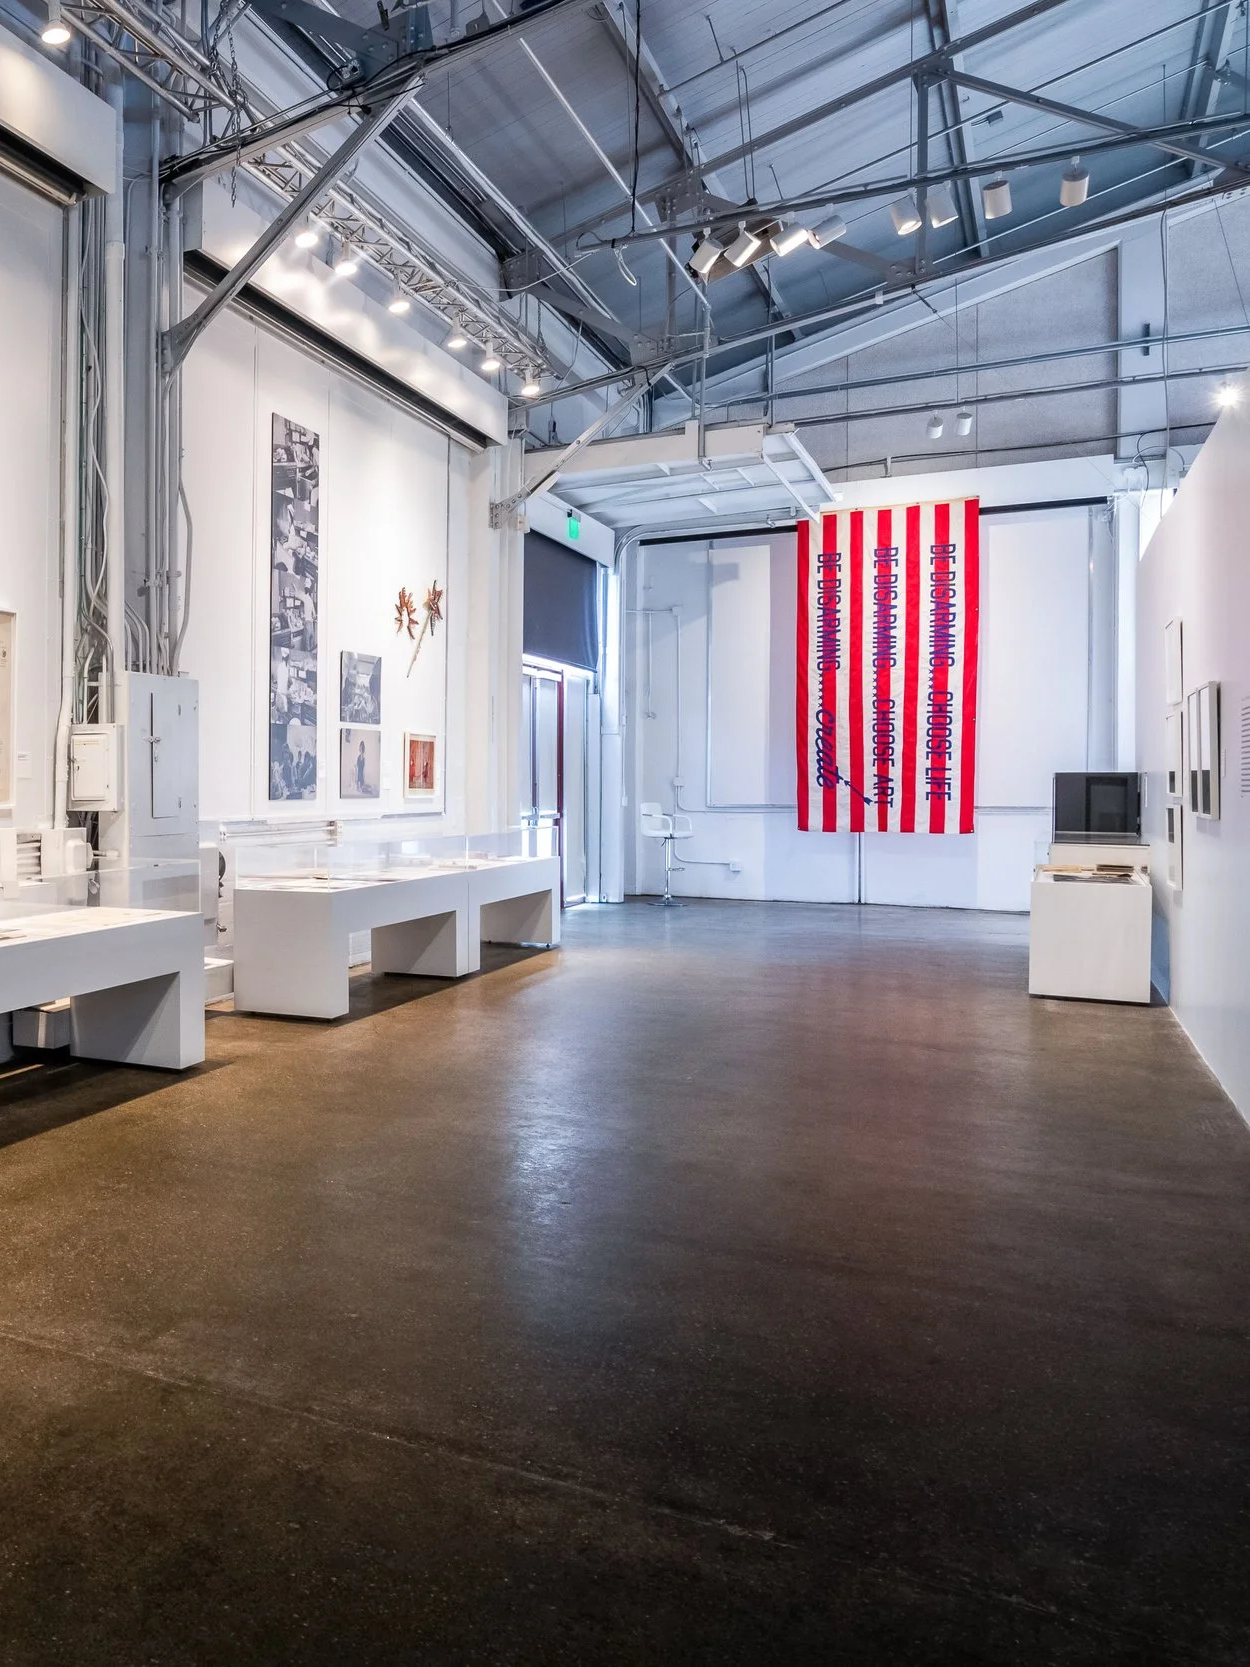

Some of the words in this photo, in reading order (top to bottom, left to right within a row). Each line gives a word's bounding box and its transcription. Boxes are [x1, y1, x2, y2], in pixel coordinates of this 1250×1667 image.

[817, 553, 842, 574] BE
[874, 547, 898, 568] BE
[930, 544, 956, 566] BE
[816, 579, 842, 671] DISARMING
[872, 574, 898, 668] DISARMING
[929, 571, 956, 667] DISARMING
[872, 699, 896, 767] CHOOSE
[926, 692, 954, 760] CHOOSE
[873, 774, 894, 808] ART
[925, 768, 952, 800] LIFE
